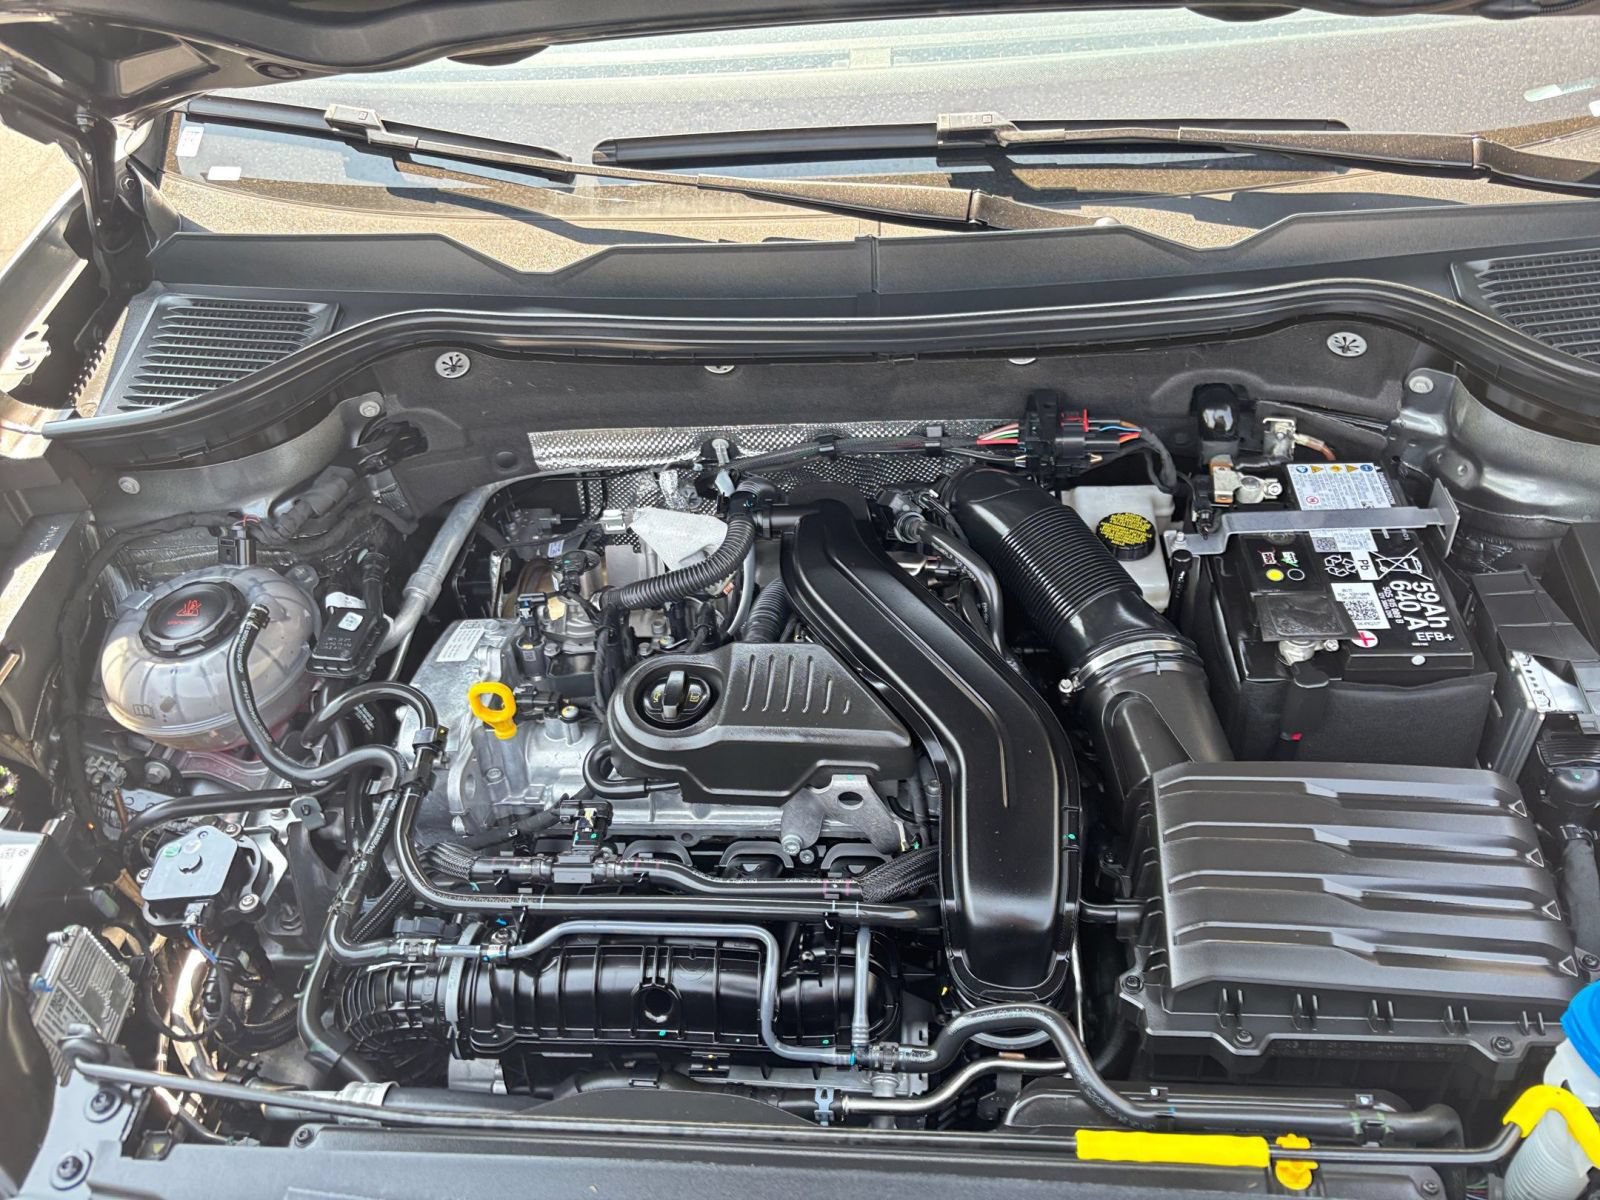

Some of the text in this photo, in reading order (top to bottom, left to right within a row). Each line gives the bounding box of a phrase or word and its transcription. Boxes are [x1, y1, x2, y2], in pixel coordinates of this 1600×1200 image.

[1358, 559, 1370, 570] Pb
[1389, 580, 1421, 612] 640
[1412, 582, 1450, 628] 59Ah
[1403, 616, 1429, 631] A
[1415, 631, 1455, 641] EFB+
